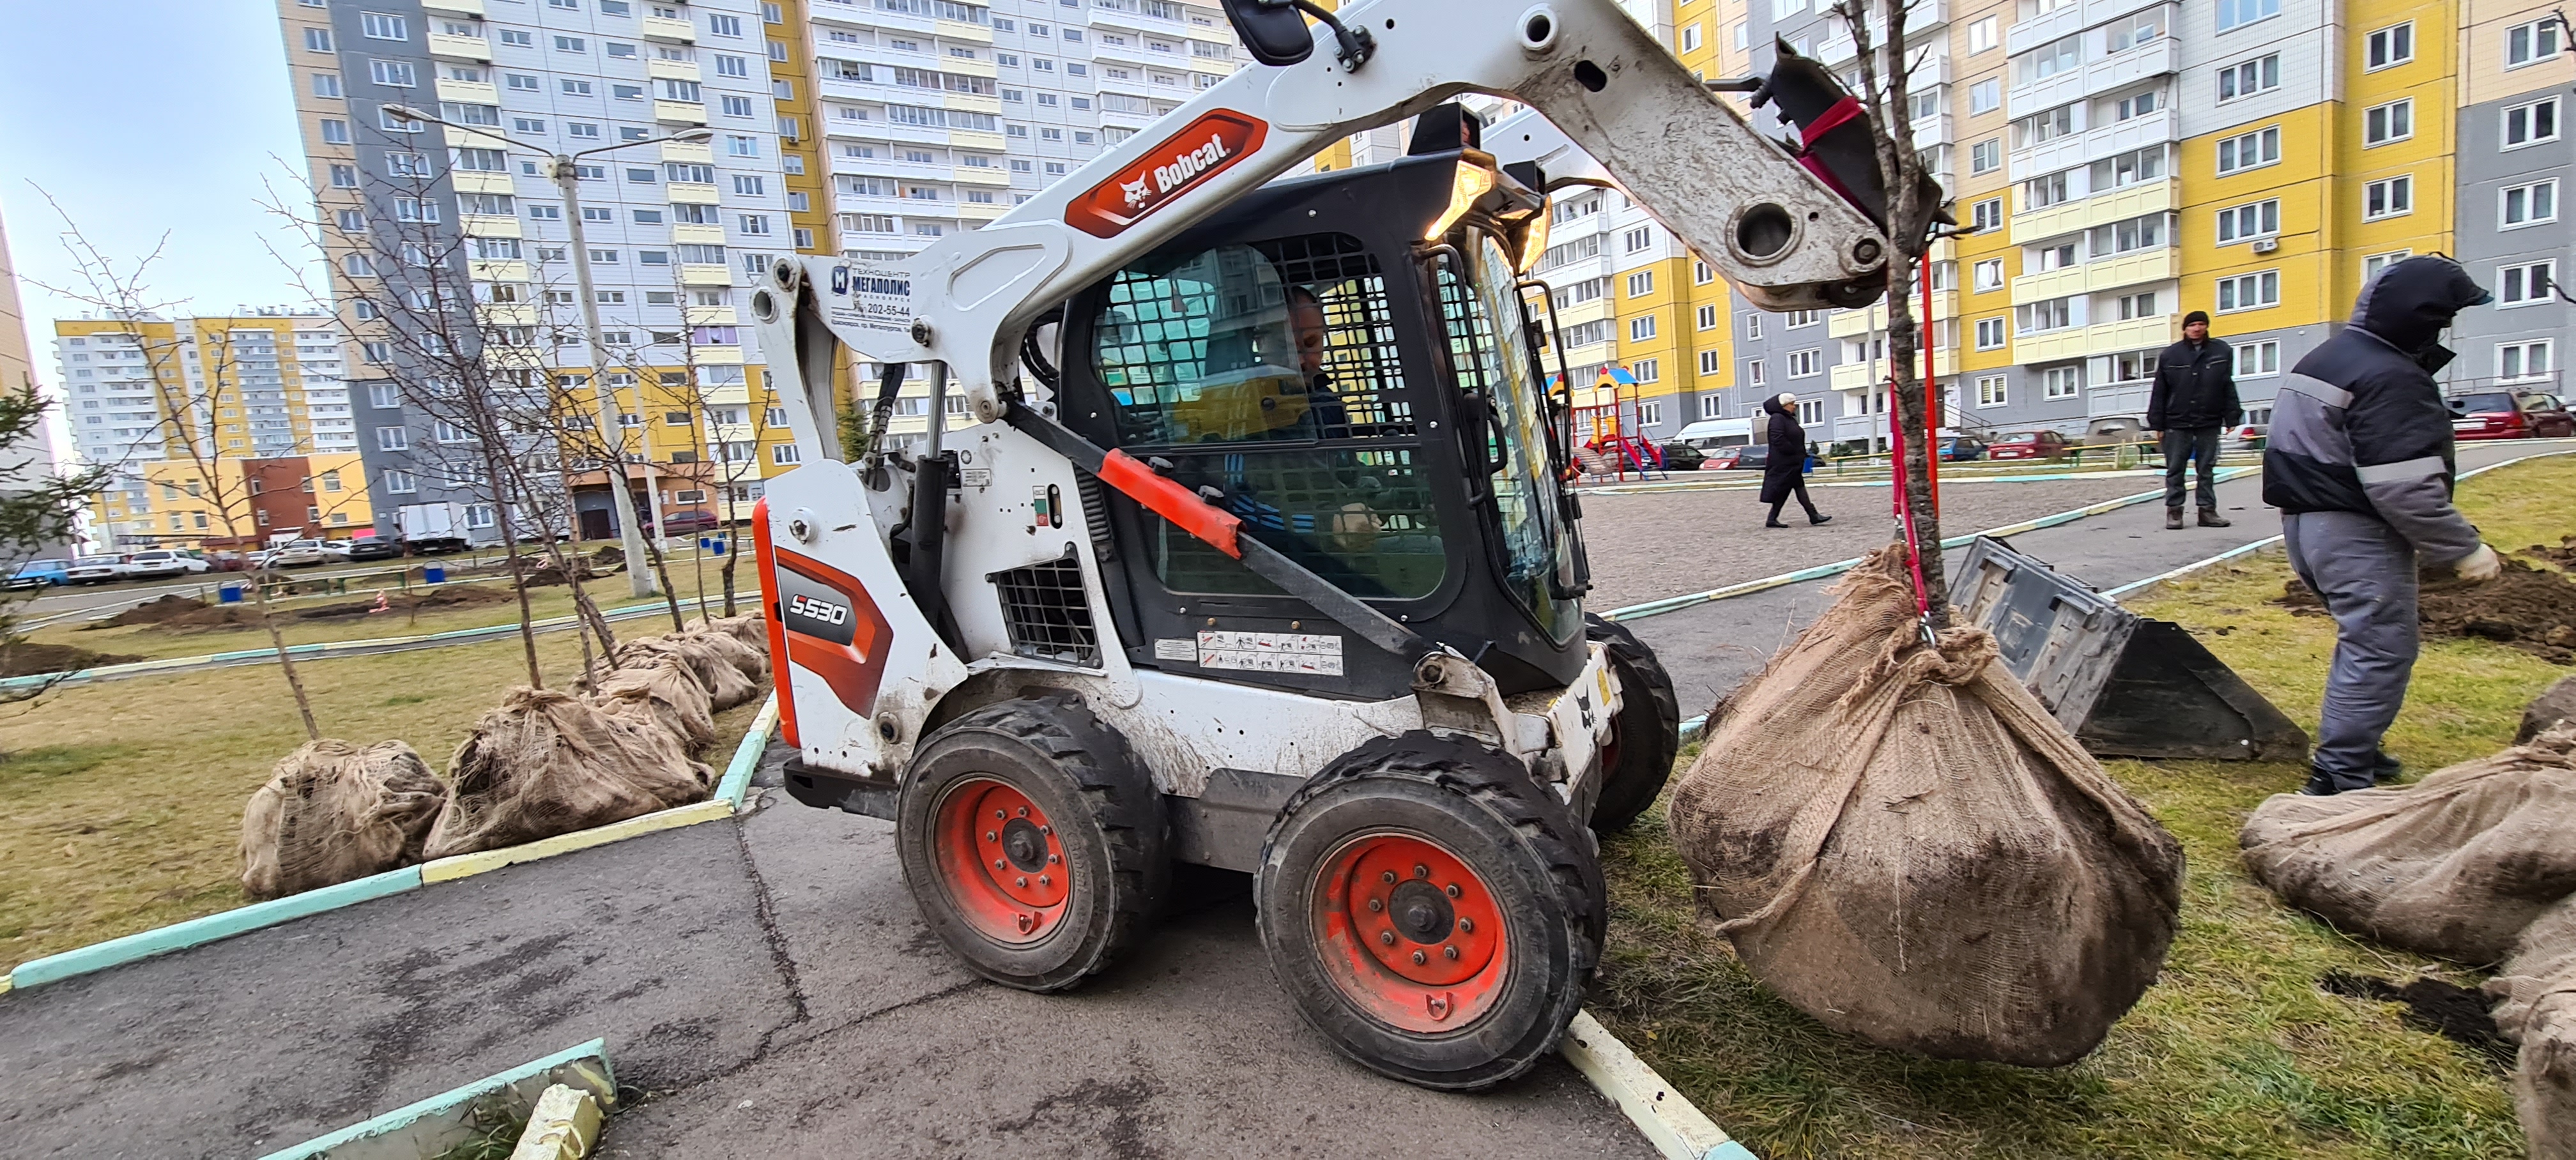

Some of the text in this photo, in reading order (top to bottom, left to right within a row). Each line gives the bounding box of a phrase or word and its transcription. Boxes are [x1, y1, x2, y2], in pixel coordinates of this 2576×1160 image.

[1153, 133, 1226, 194] Bobcat
[852, 268, 910, 278] ТЕХНОЦЕНТР
[852, 276, 910, 296] МЕГАПОЛИС
[868, 303, 910, 317] 202-55-44
[789, 593, 848, 626] S530
